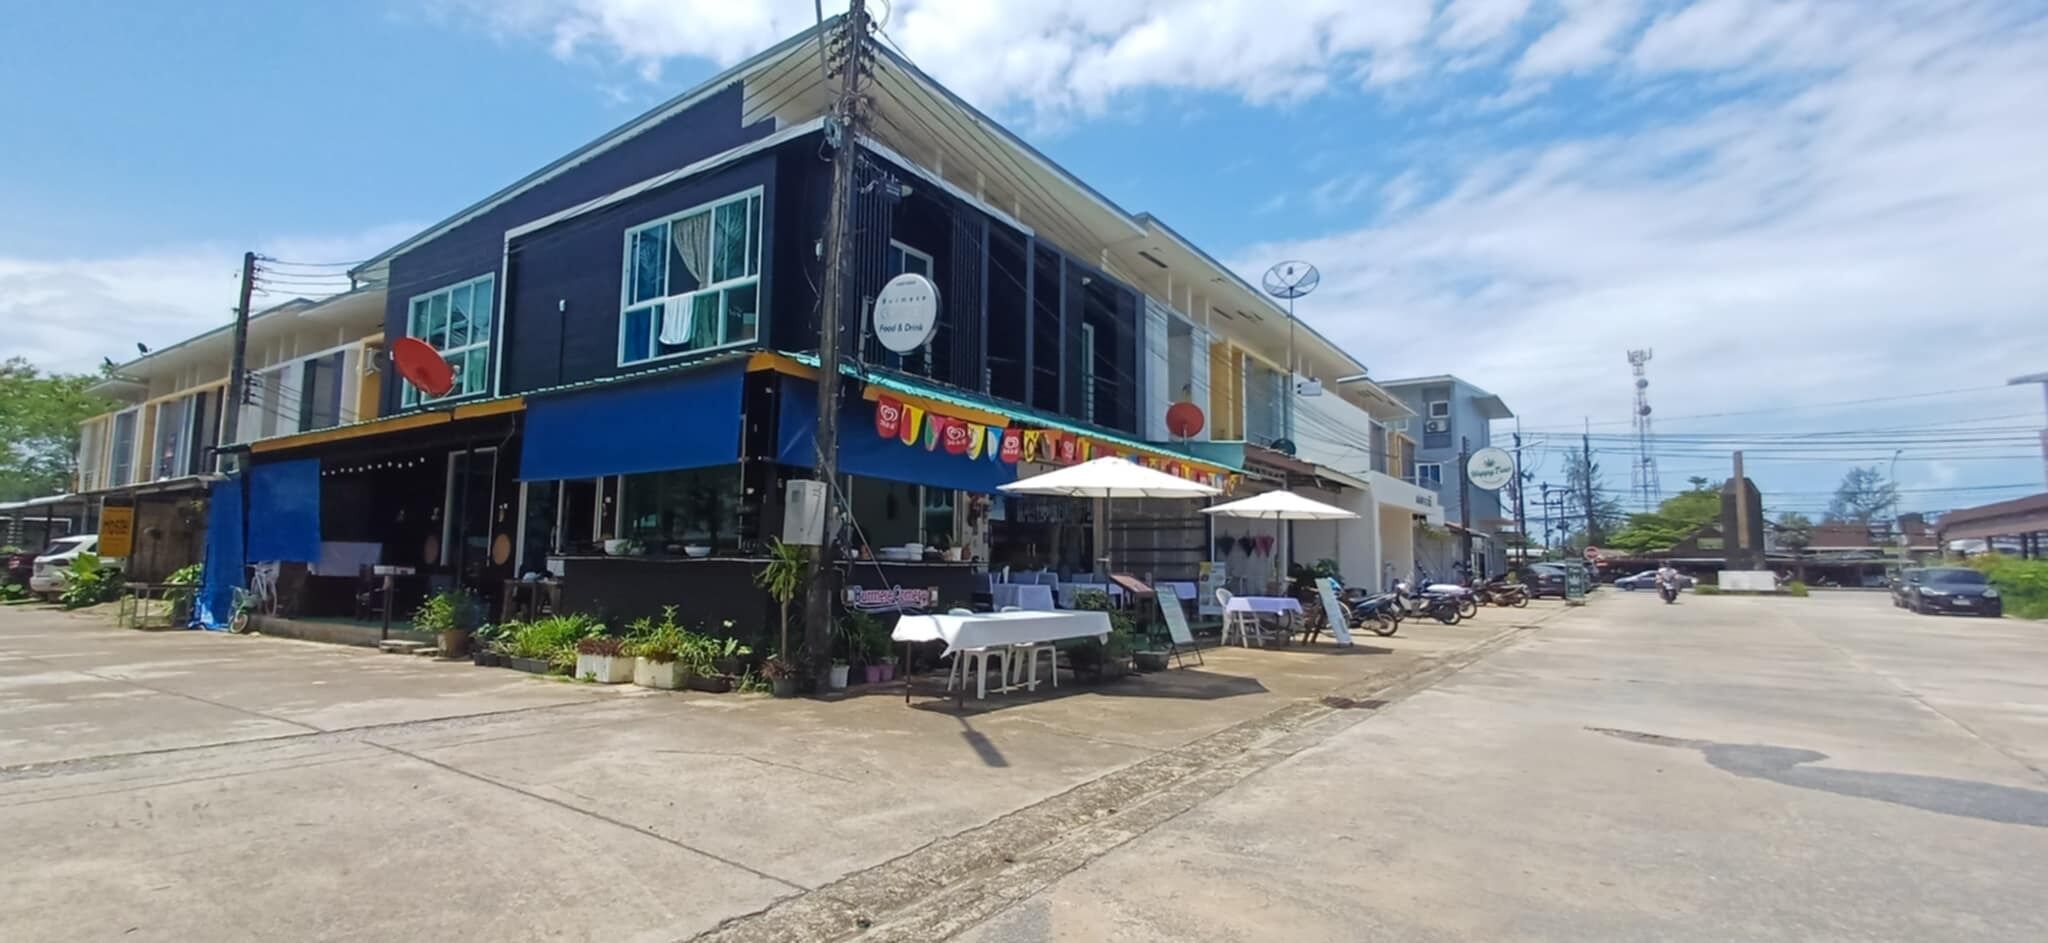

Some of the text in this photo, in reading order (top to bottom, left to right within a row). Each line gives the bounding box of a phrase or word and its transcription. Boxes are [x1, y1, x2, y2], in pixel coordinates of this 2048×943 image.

[879, 322, 923, 332] Food & Drink
